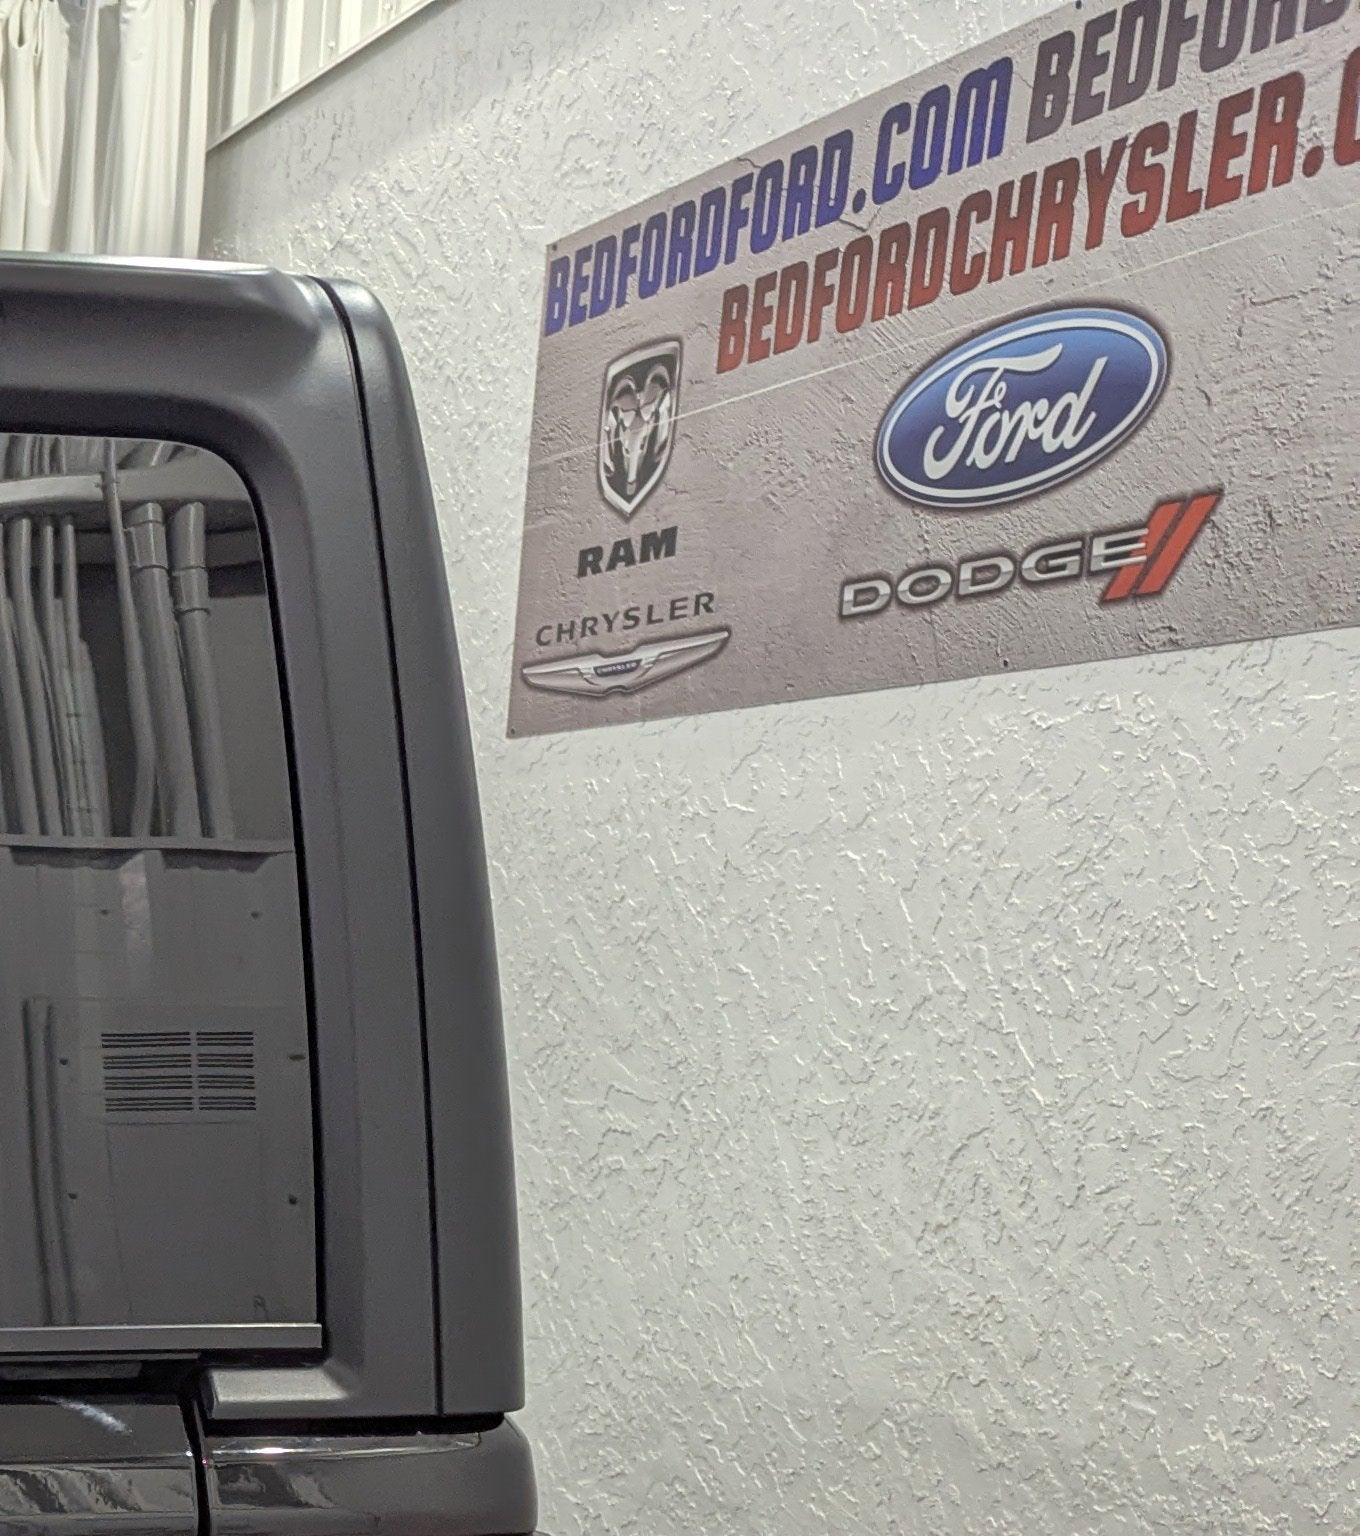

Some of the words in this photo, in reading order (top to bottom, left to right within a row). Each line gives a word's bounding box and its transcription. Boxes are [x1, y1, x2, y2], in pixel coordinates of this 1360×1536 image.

[543, 56, 1014, 337] BEDFORDFORD.COM
[923, 342, 1109, 480] Ford
[577, 525, 678, 578] RAM
[840, 527, 1149, 617] DODGE
[535, 592, 715, 646] CHRYSLER
